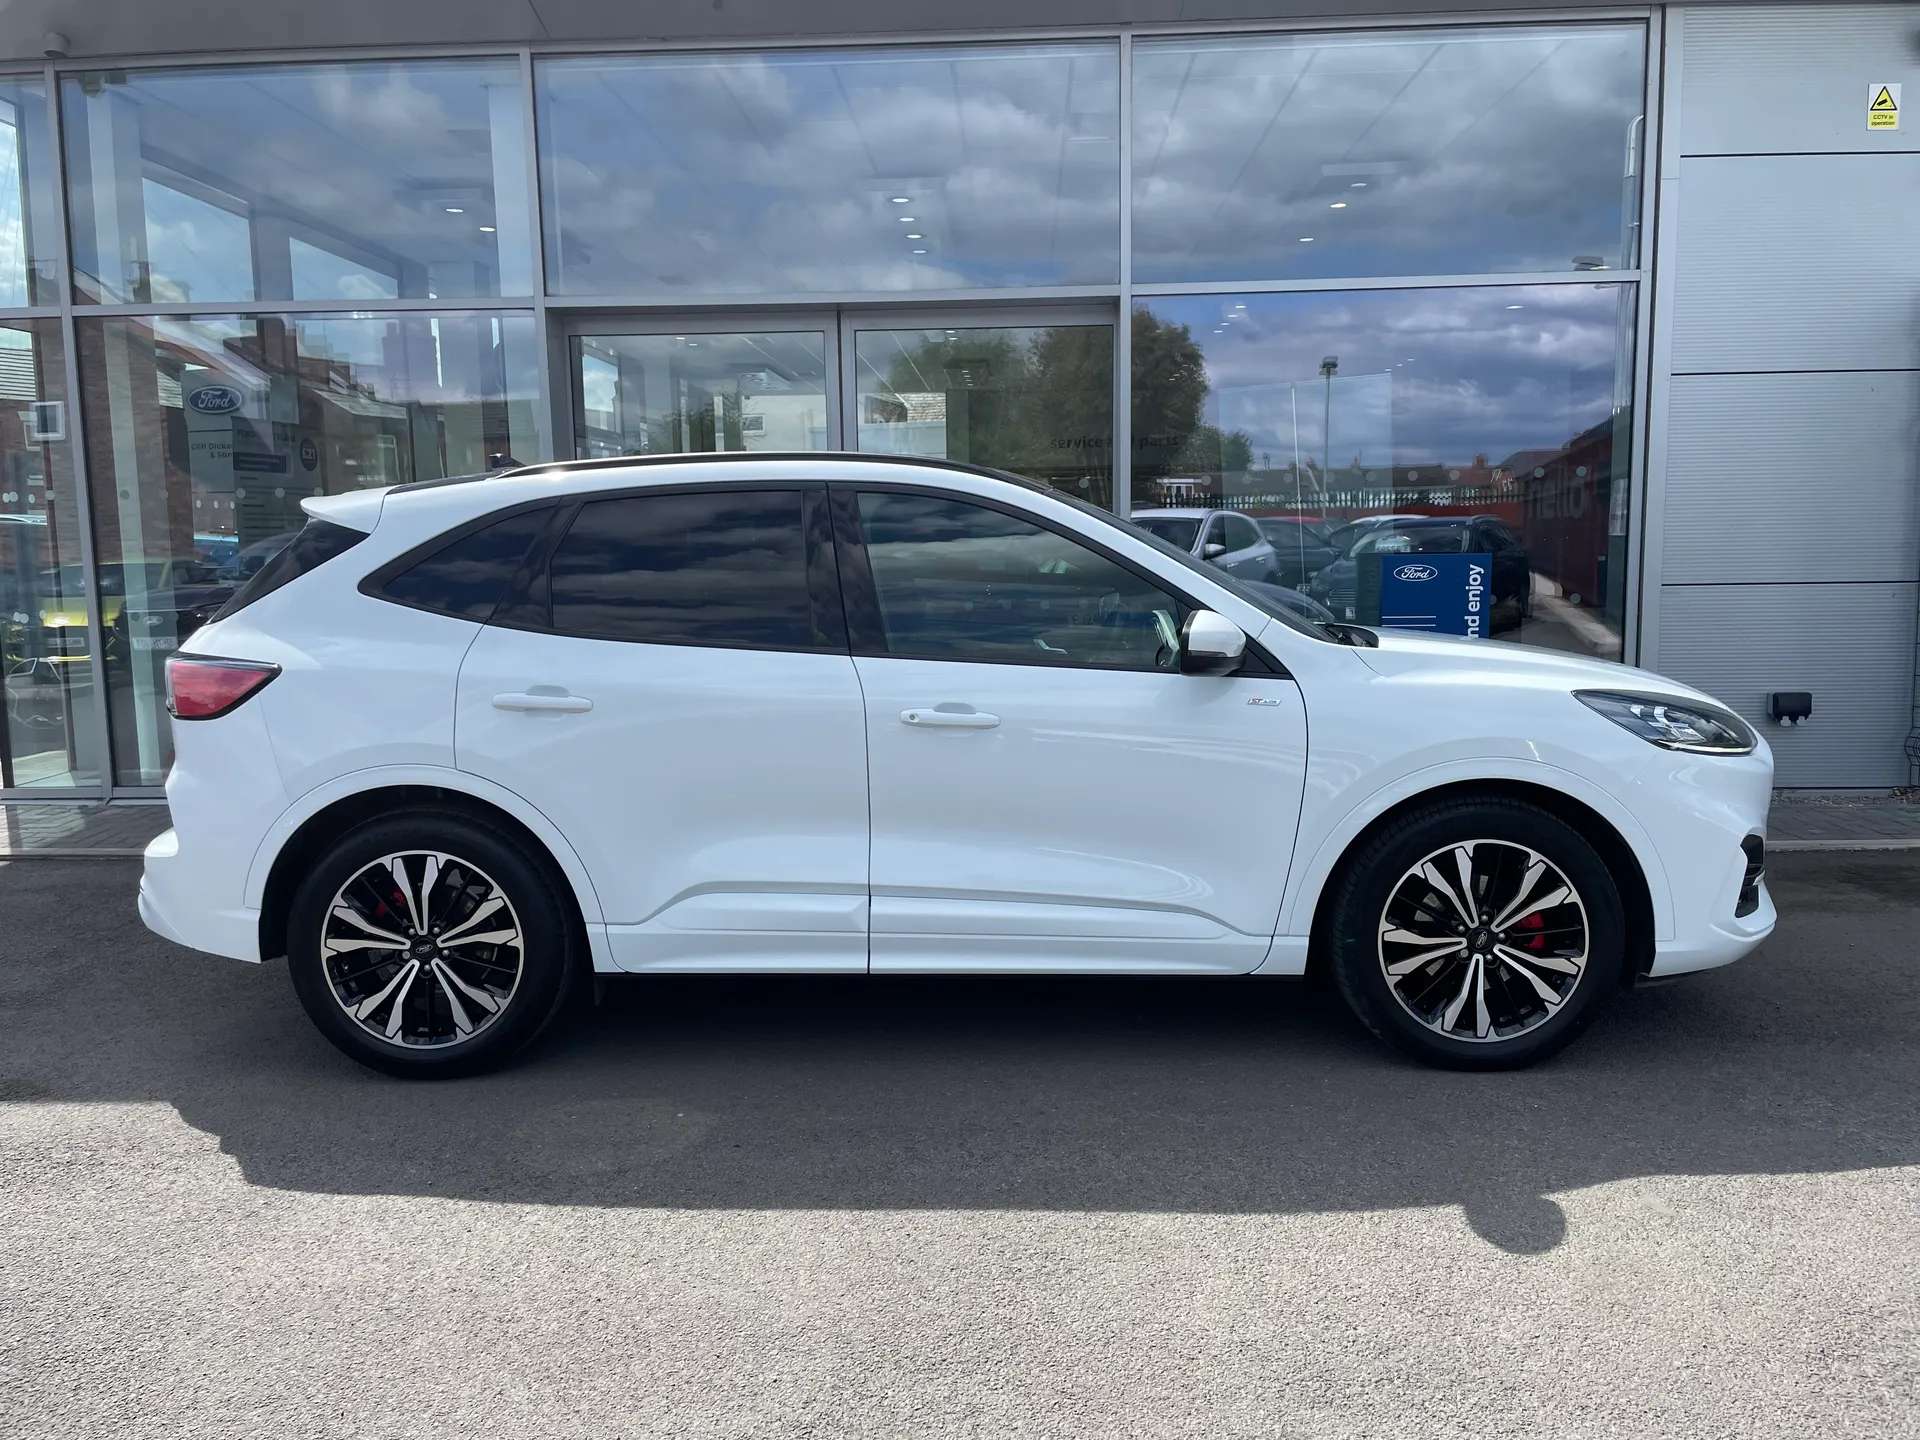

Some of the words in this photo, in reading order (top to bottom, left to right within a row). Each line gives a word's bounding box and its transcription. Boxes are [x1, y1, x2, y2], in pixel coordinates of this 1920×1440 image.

[198, 389, 230, 408] Ford
[1049, 436, 1100, 449] service
[1401, 566, 1429, 579] Ford
[1465, 564, 1484, 612] enjoy
[1464, 615, 1481, 639] nd
